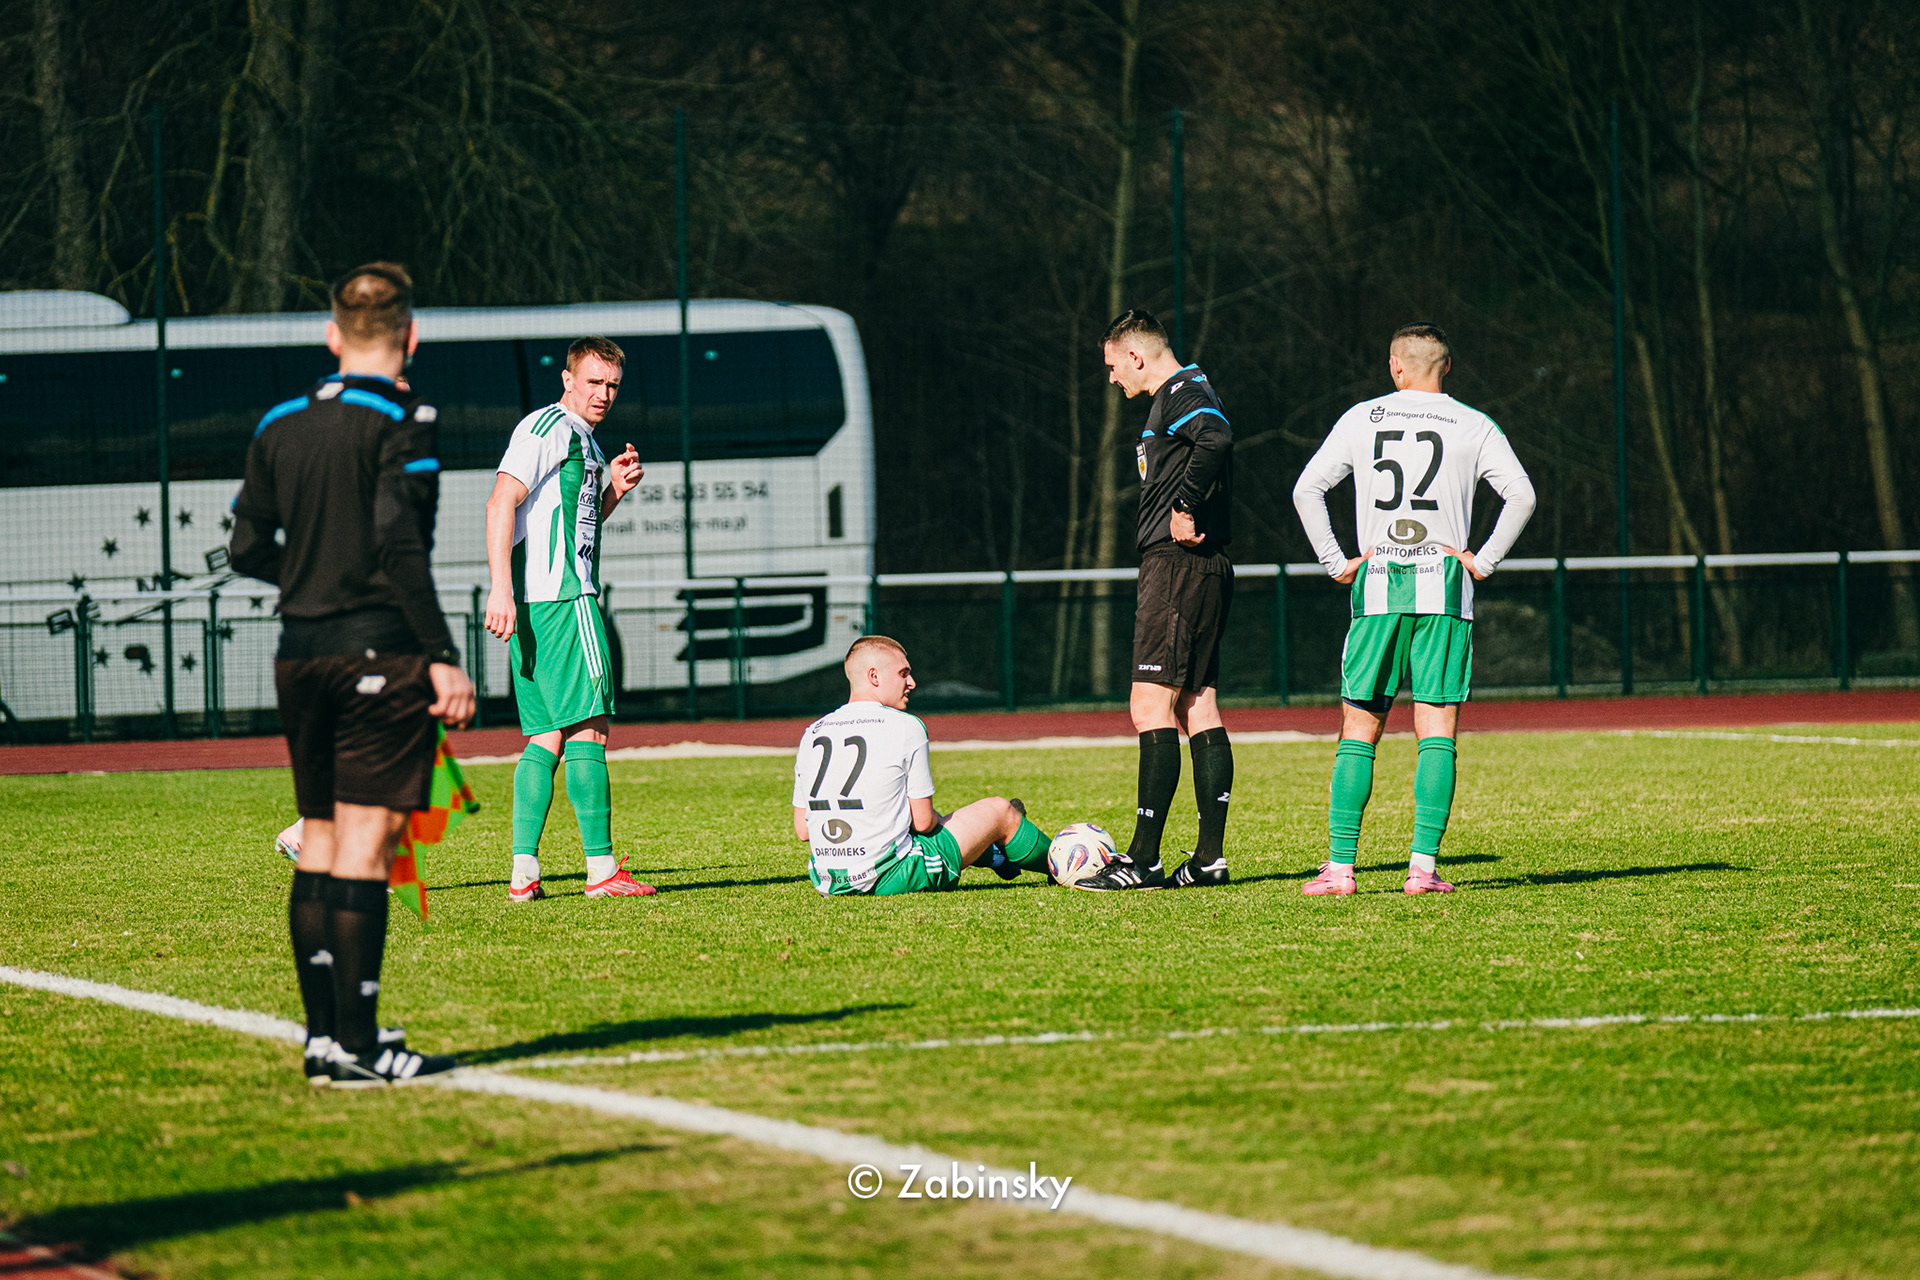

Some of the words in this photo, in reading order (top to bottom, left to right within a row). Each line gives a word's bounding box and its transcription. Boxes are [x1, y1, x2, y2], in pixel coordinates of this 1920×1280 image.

[1386, 410, 1425, 419] Starogard
[1373, 430, 1444, 511] 52
[1375, 546, 1438, 557] DARTOMEKS
[1409, 565, 1435, 575] KEBAB
[808, 735, 868, 811] 22
[815, 847, 866, 857] DARTOMEKS
[844, 871, 867, 883] KEBAB
